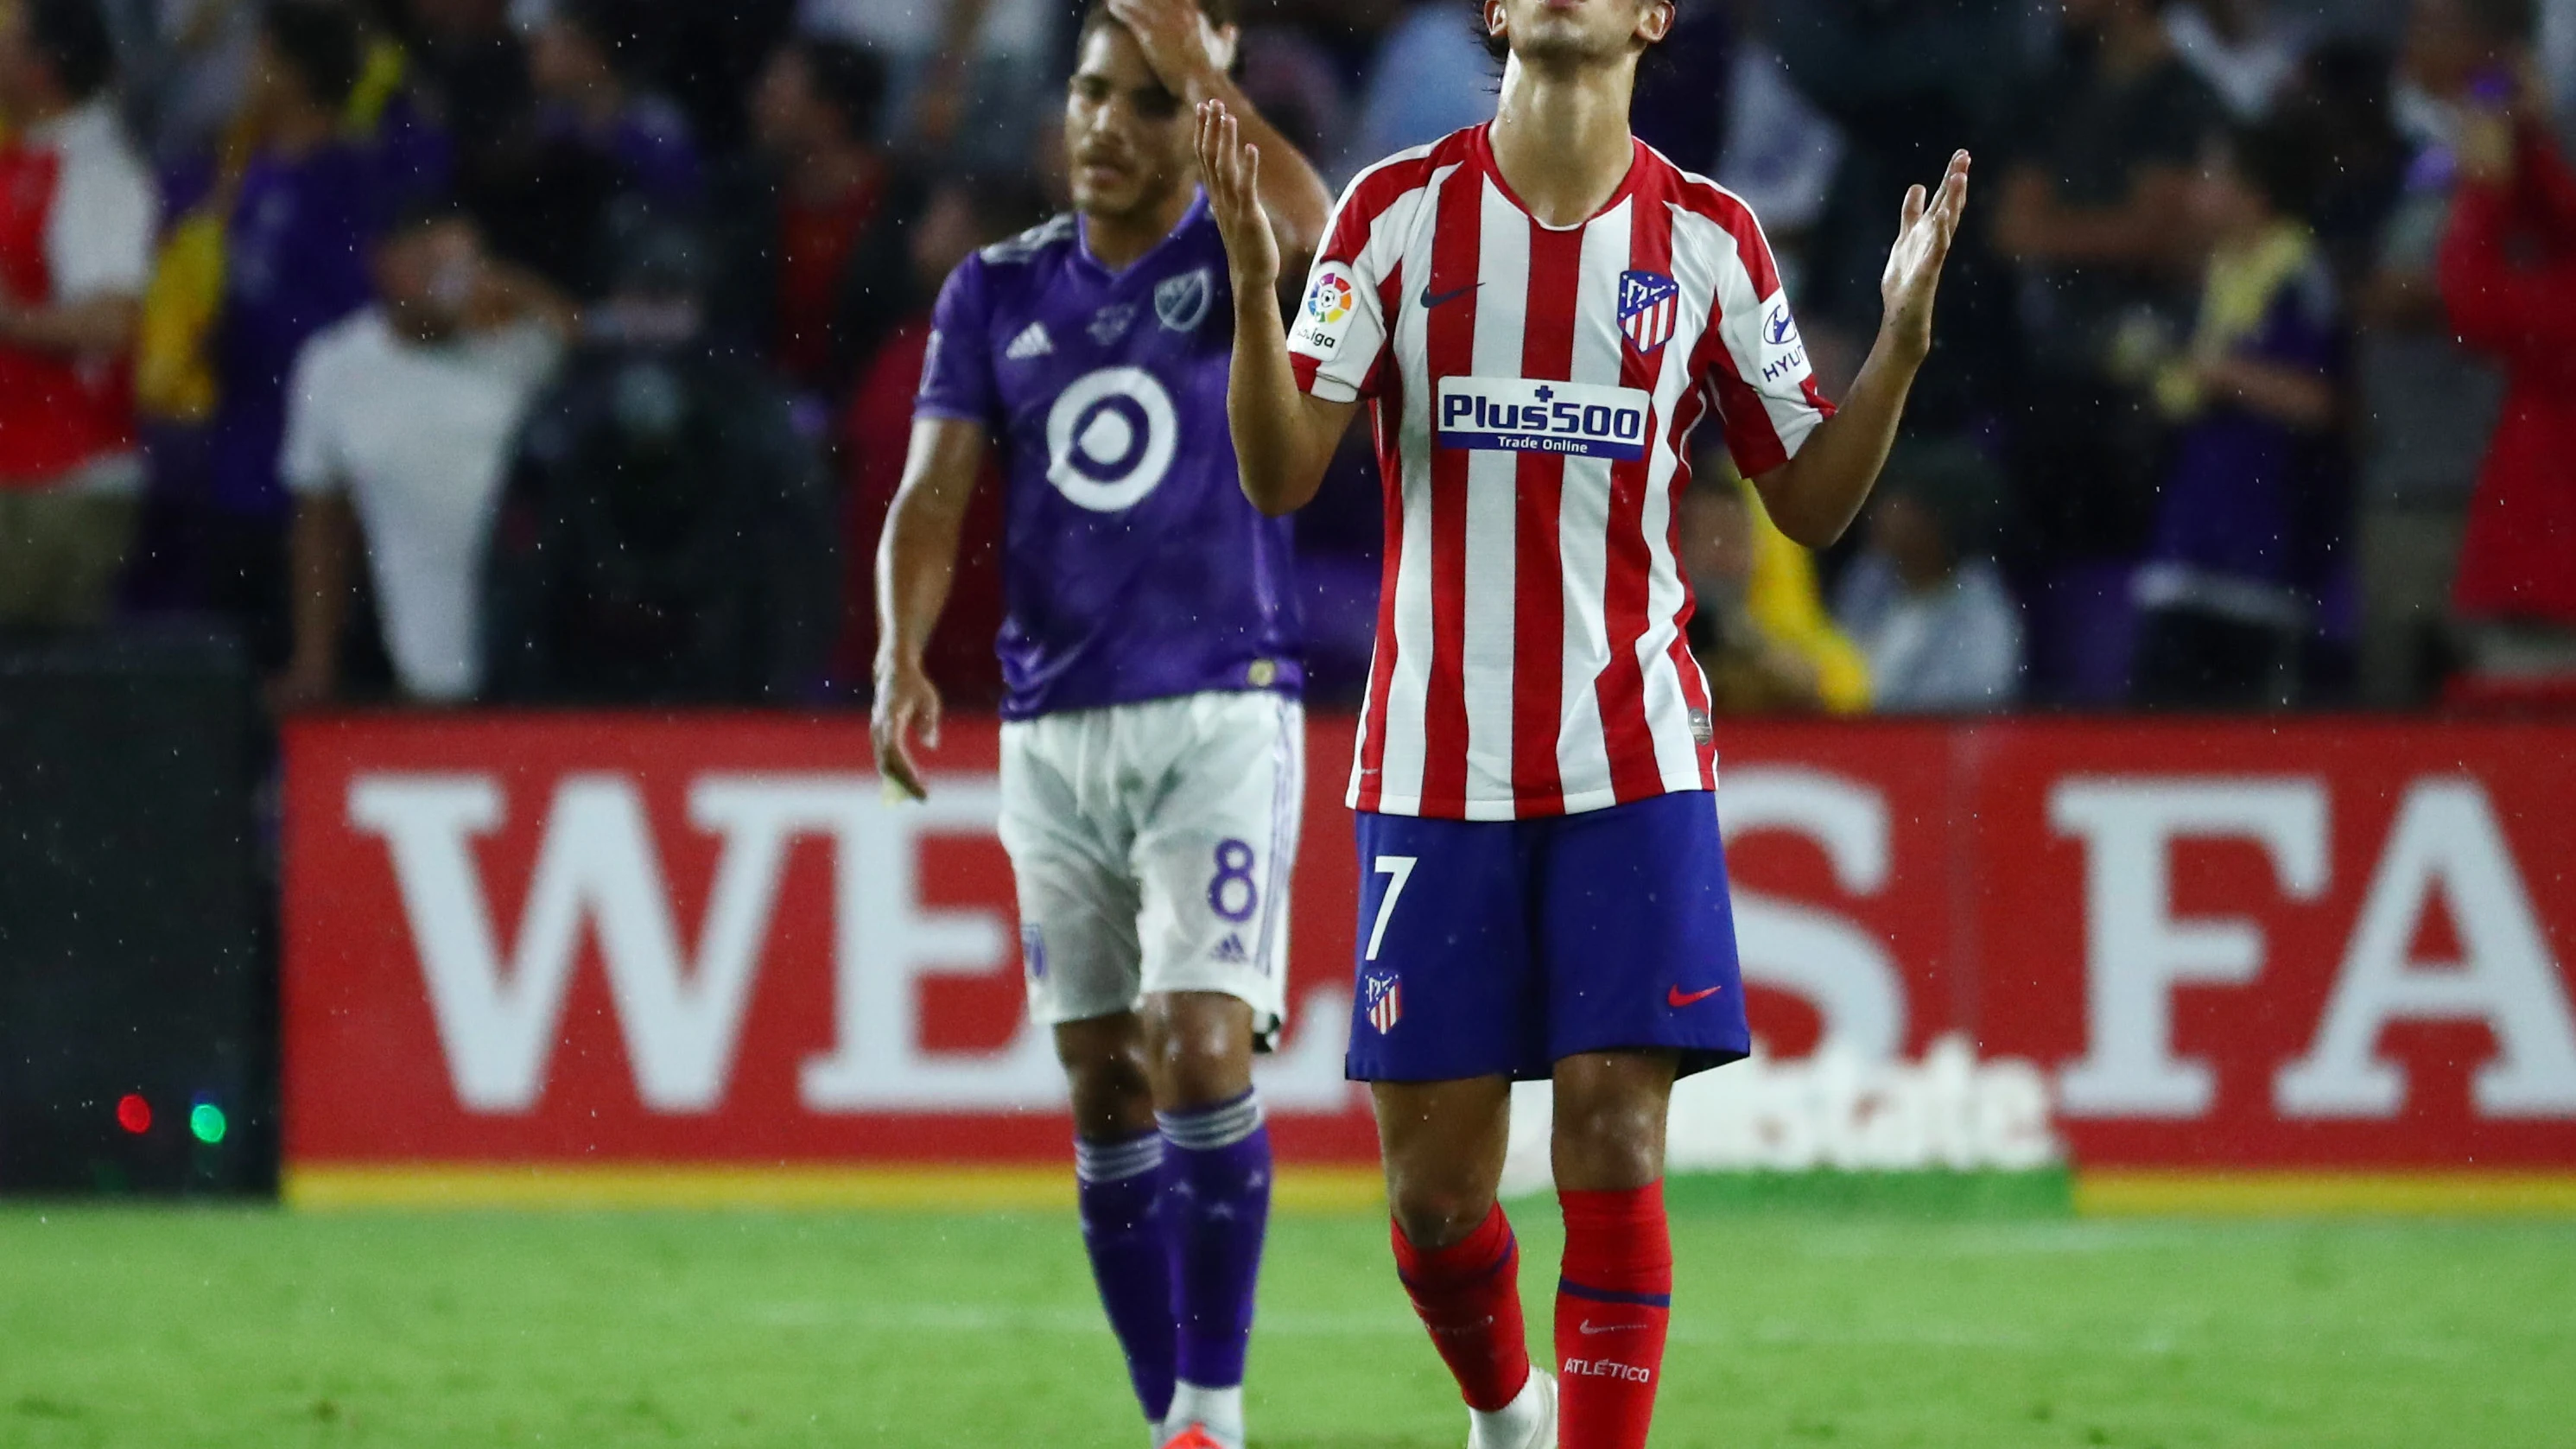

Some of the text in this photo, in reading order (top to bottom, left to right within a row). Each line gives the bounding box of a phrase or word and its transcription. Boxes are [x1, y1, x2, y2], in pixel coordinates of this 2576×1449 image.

[1443, 393, 1640, 440] Plus500
[1498, 435, 1589, 454] Trade Online
[1208, 836, 1258, 923] 8
[1365, 855, 1418, 961] 7
[1564, 1357, 1651, 1383] ATLÉTICO
